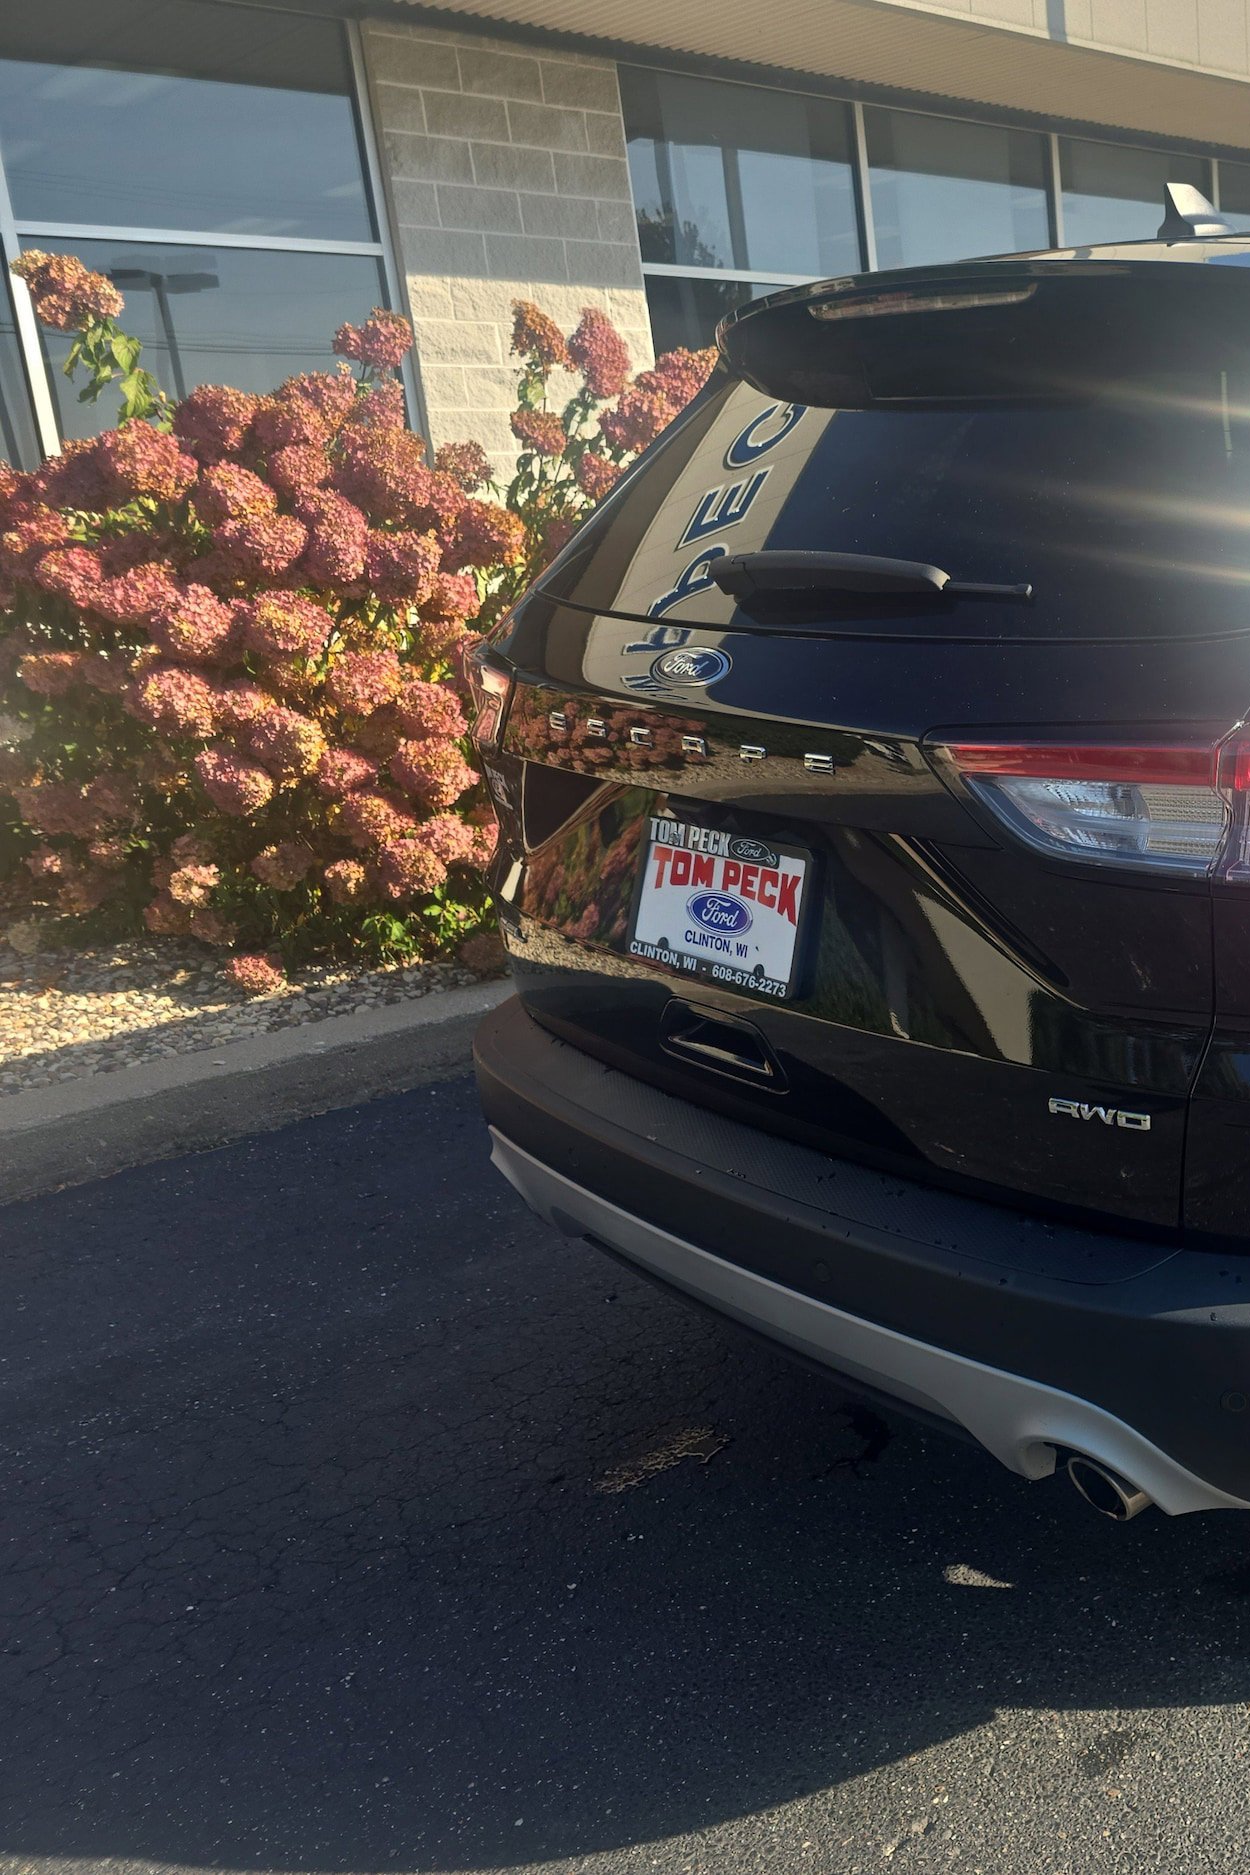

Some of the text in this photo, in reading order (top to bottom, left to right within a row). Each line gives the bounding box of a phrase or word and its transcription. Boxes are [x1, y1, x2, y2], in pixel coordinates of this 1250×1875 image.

[663, 652, 703, 678] Ford
[549, 711, 836, 775] ESCAPE
[650, 817, 732, 858] TOM PECK
[652, 845, 802, 928] TOM PECK
[701, 897, 740, 929] Ford
[684, 929, 749, 958] CLINTON, WI
[630, 941, 680, 969] CLINTON,
[683, 956, 698, 972] WI
[711, 964, 787, 998] 608-676-2273
[1048, 1097, 1151, 1131] AWD
